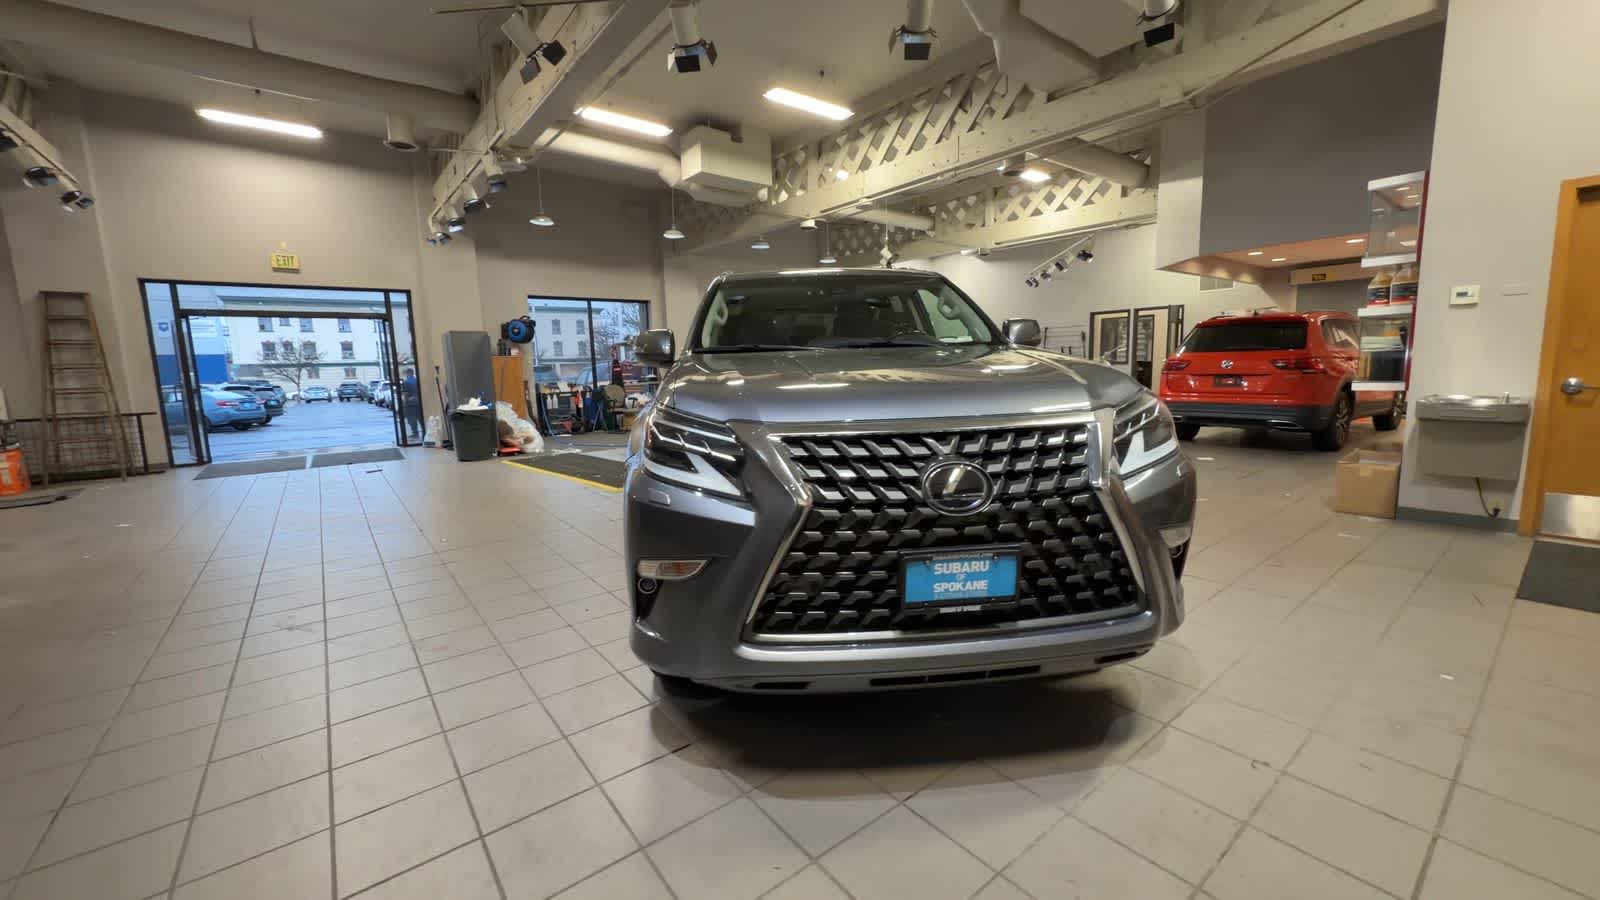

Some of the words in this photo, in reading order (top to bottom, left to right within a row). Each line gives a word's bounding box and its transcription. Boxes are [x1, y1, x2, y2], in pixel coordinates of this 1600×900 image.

[275, 254, 295, 267] EXIT
[934, 560, 990, 575] SUBARU
[955, 573, 968, 581] OF
[932, 579, 989, 593] SPOKANE
